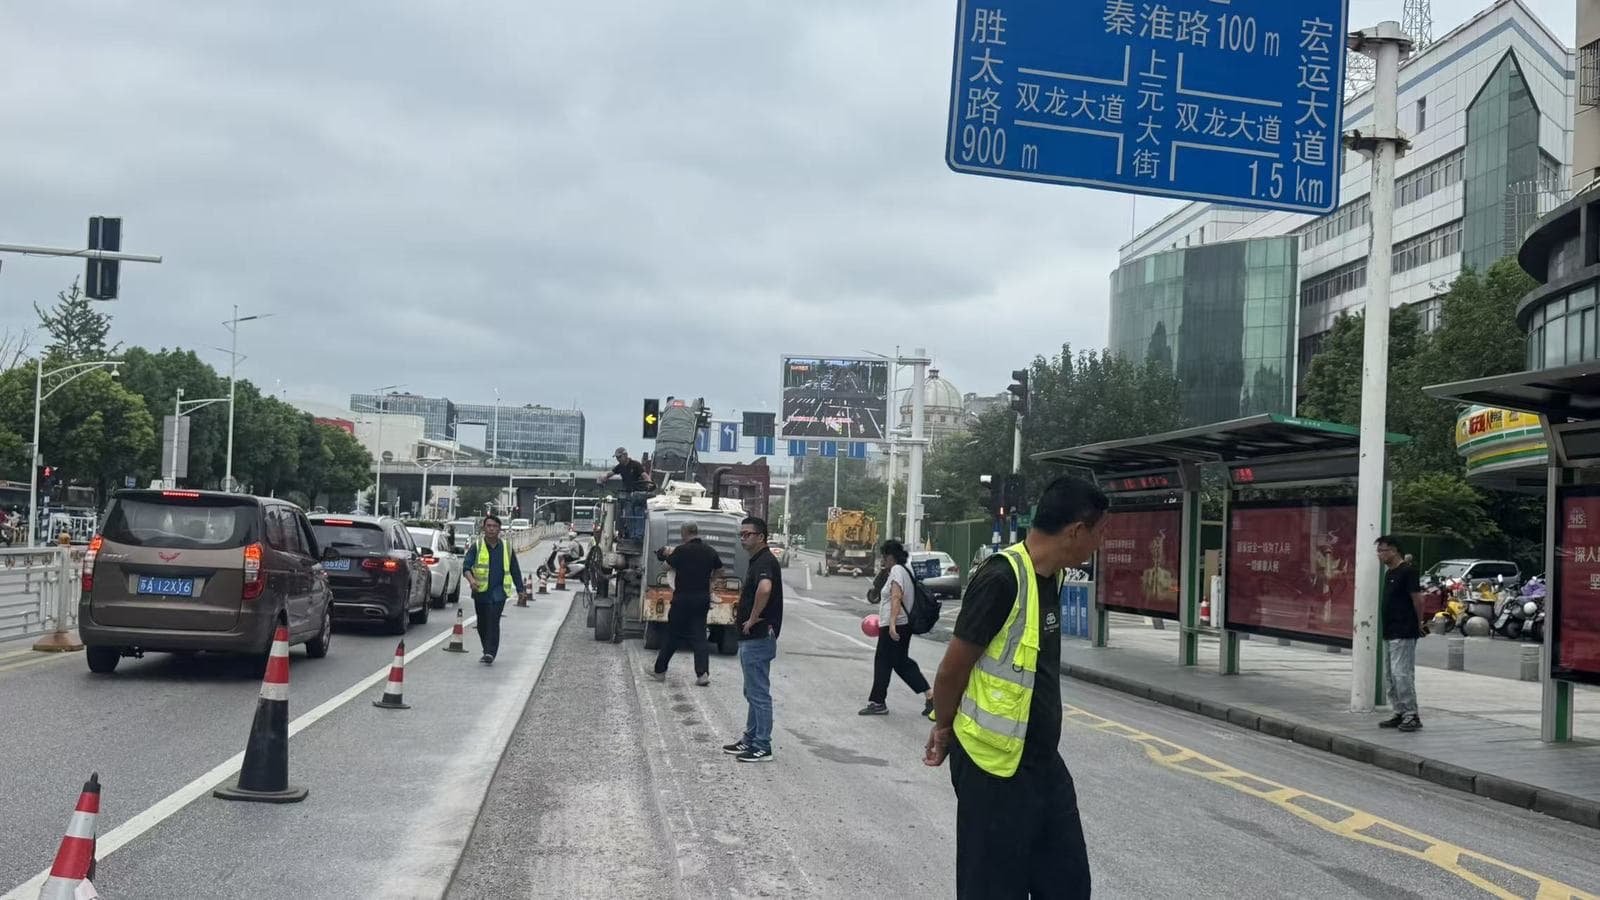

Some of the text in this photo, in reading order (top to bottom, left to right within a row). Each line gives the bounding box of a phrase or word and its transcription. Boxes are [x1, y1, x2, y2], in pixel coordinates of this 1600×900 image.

[1103, 0, 1280, 57] 秦淮路 100 m
[965, 7, 1007, 126] 胜太路
[1292, 16, 1333, 167] 宏运大道
[1015, 81, 1126, 125] 双龙大道
[1132, 49, 1168, 180] 上元大街
[1174, 101, 1282, 146] 双龙大道
[962, 127, 1038, 170] 900 m
[1248, 160, 1324, 205] 1.5 km
